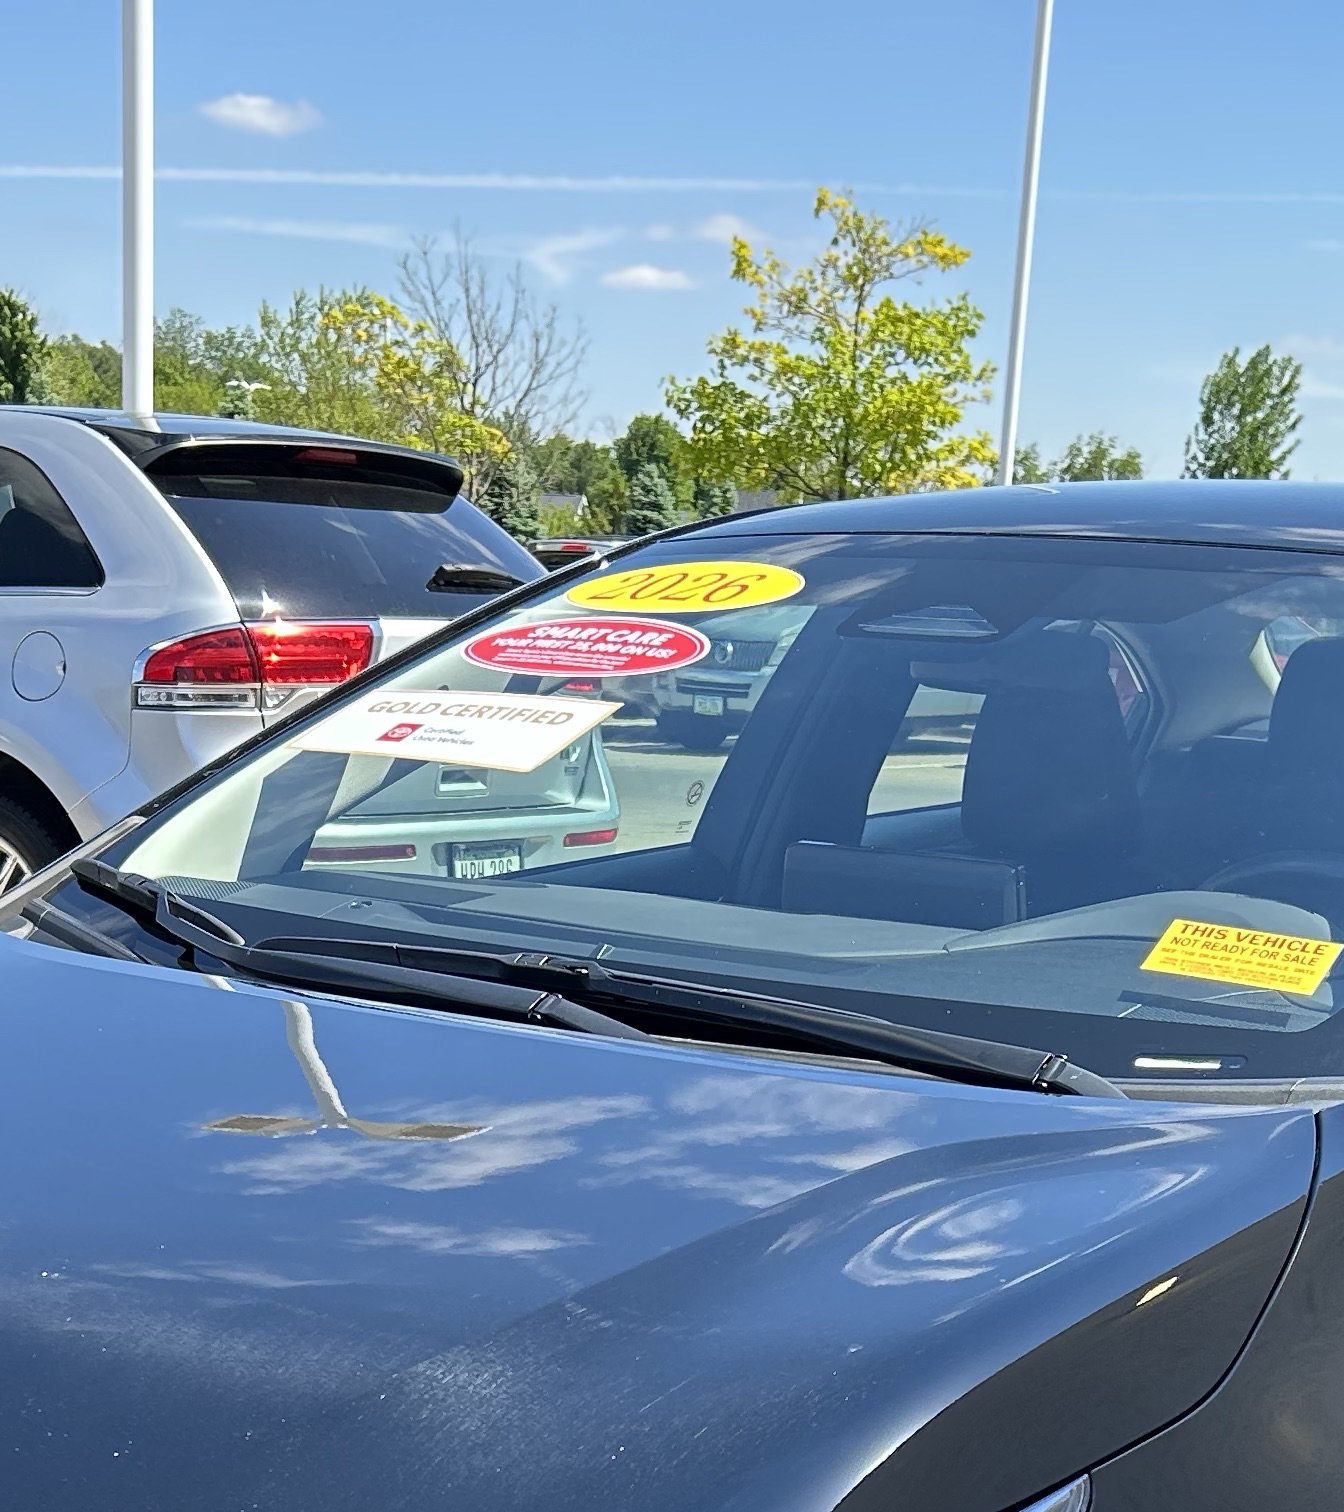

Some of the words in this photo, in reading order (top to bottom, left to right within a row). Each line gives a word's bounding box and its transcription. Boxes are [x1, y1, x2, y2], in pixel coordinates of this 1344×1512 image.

[586, 573, 767, 603] 2026
[527, 626, 611, 643] SMART
[606, 629, 676, 646] CARE
[528, 638, 571, 650] FIRST
[368, 701, 441, 716] GOLD
[439, 703, 575, 726] CERTIFIED
[1170, 936, 1202, 949] NOT
[1200, 940, 1249, 955] READY
[1250, 948, 1280, 960] FOR
[1281, 953, 1320, 967] SALE
[1180, 923, 1231, 940] THIS
[1235, 931, 1330, 956] VEHICLE
